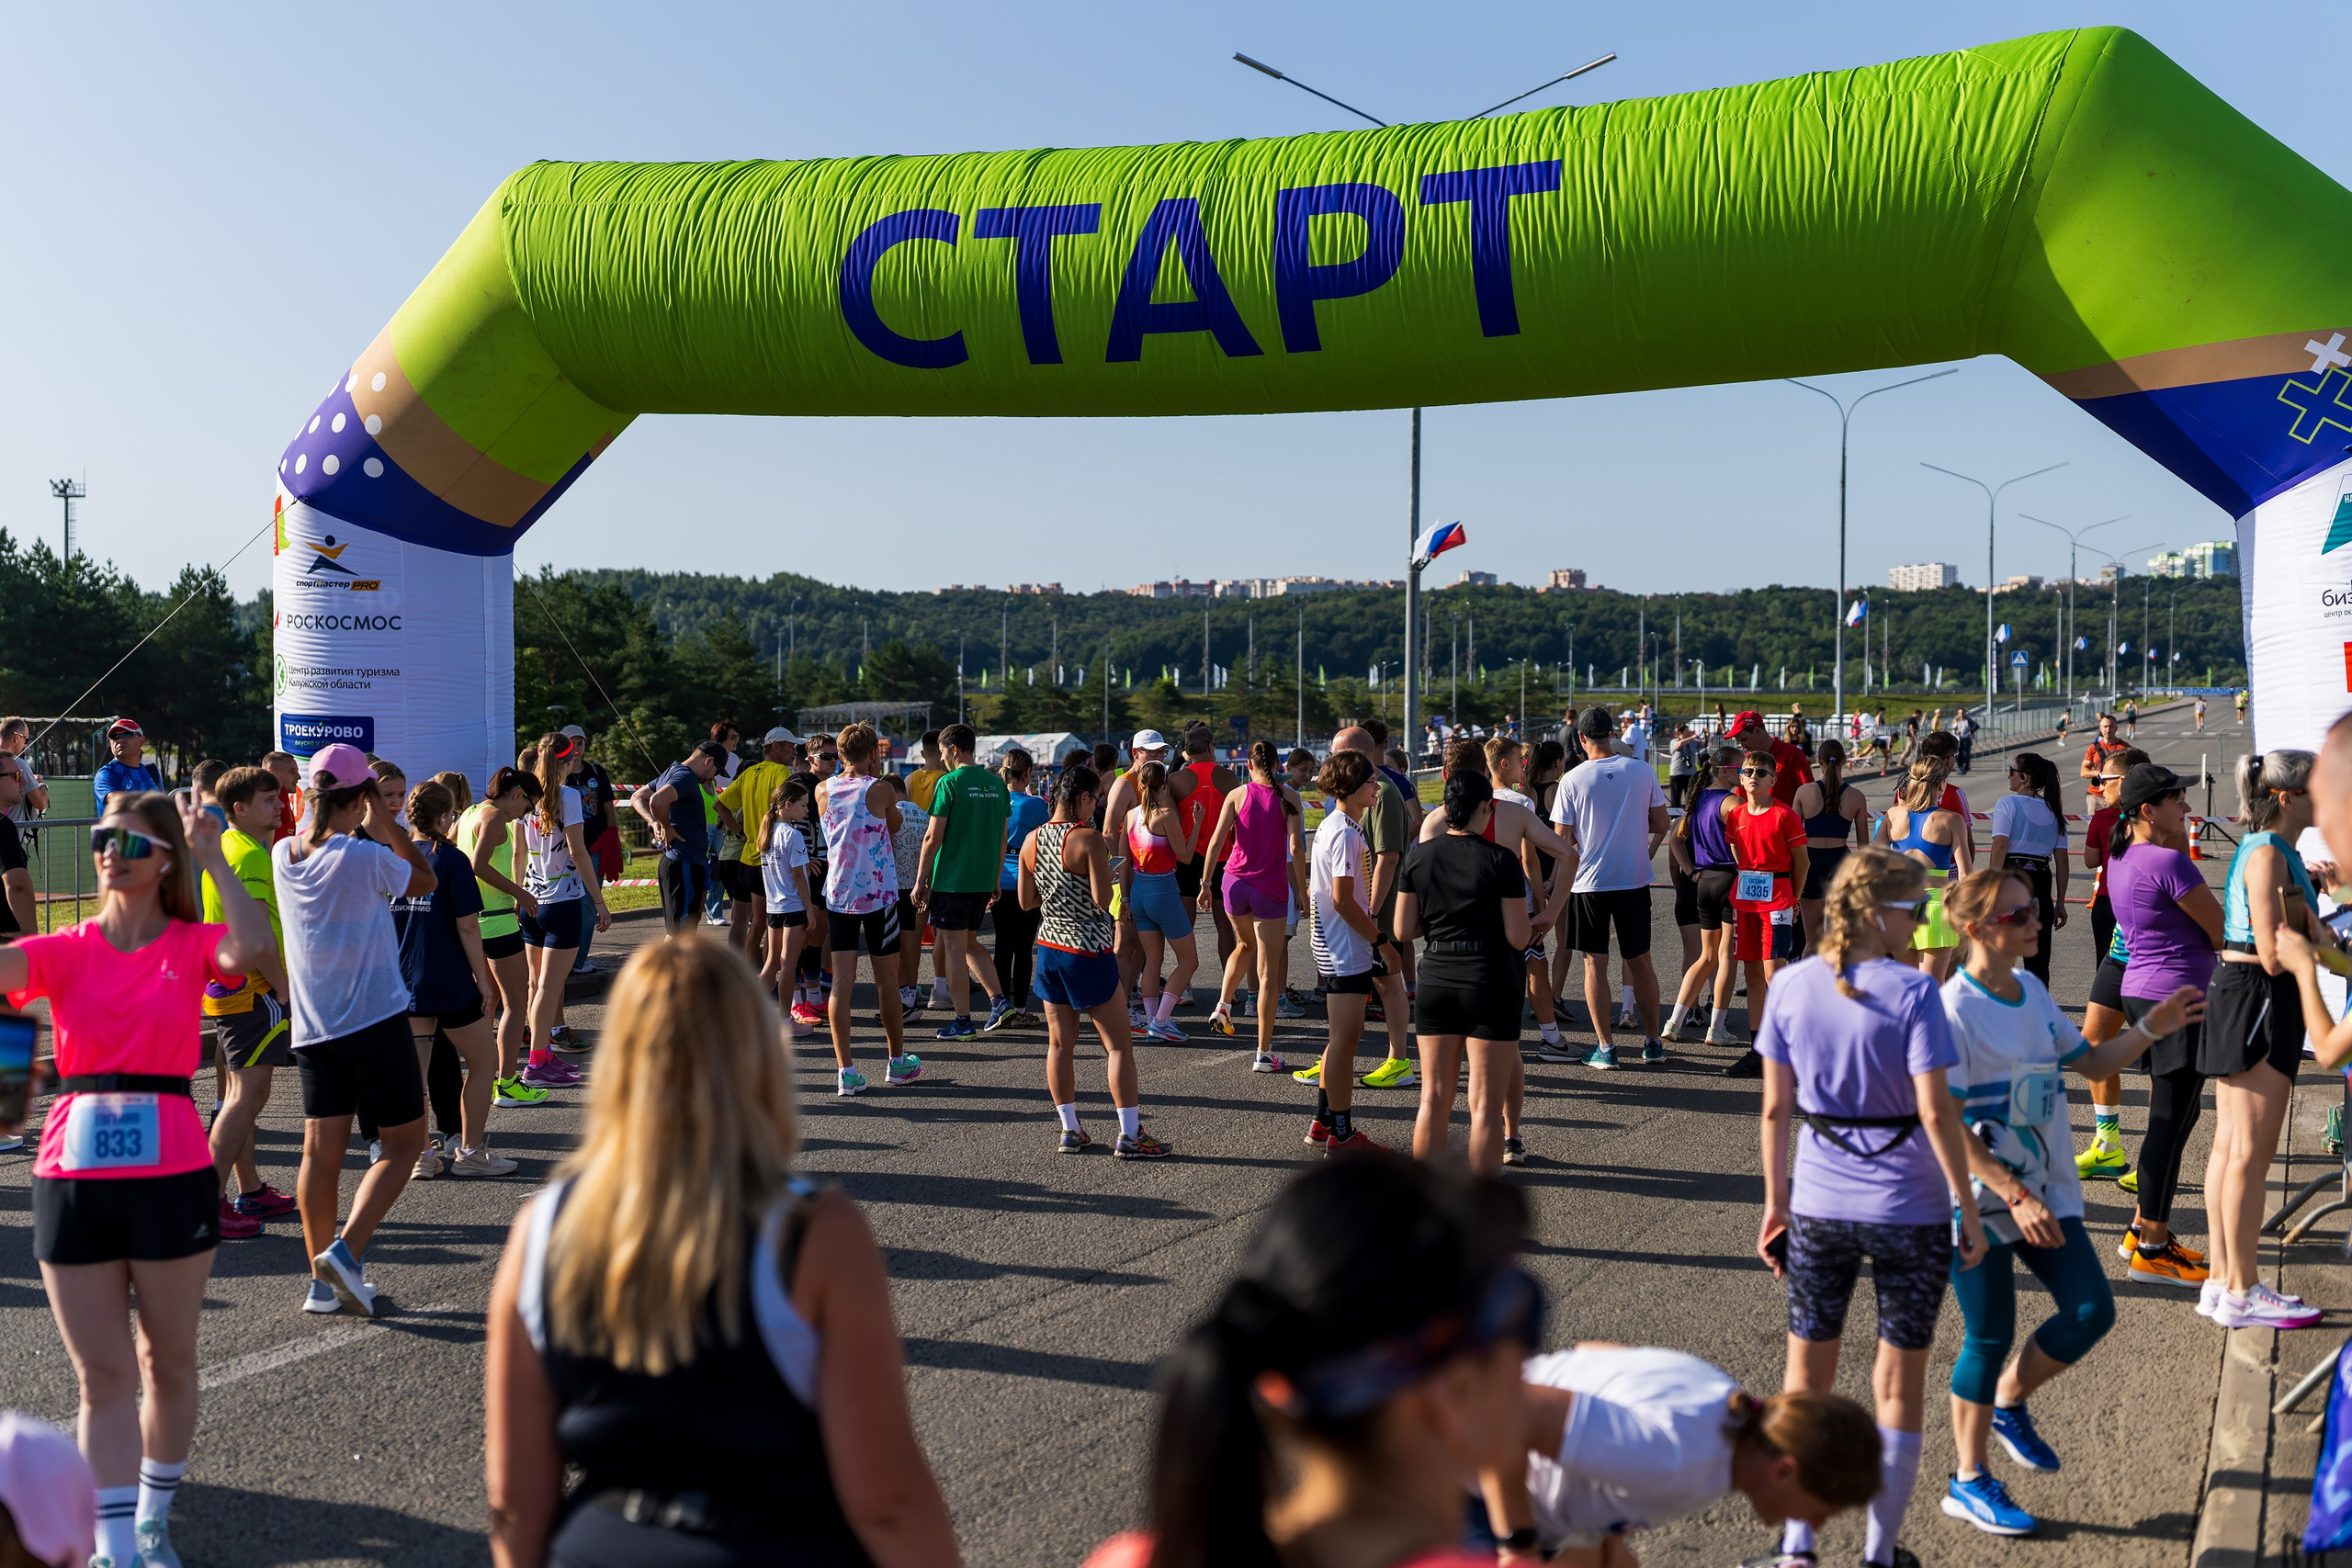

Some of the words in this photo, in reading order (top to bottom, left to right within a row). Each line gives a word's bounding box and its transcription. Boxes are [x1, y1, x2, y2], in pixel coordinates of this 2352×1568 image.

[839, 159, 1561, 368] СТАРТ
[2324, 610, 2342, 618] центр
[287, 614, 401, 631] РОСКОСМОС
[288, 665, 310, 676] Центр
[311, 668, 354, 677] развития
[356, 669, 401, 678] туризма
[288, 678, 329, 690] Калужской
[330, 679, 371, 689] области
[285, 723, 364, 739] ТРОЕКУРОВО
[1746, 885, 1769, 898] 4335
[95, 1128, 141, 1158] 833
